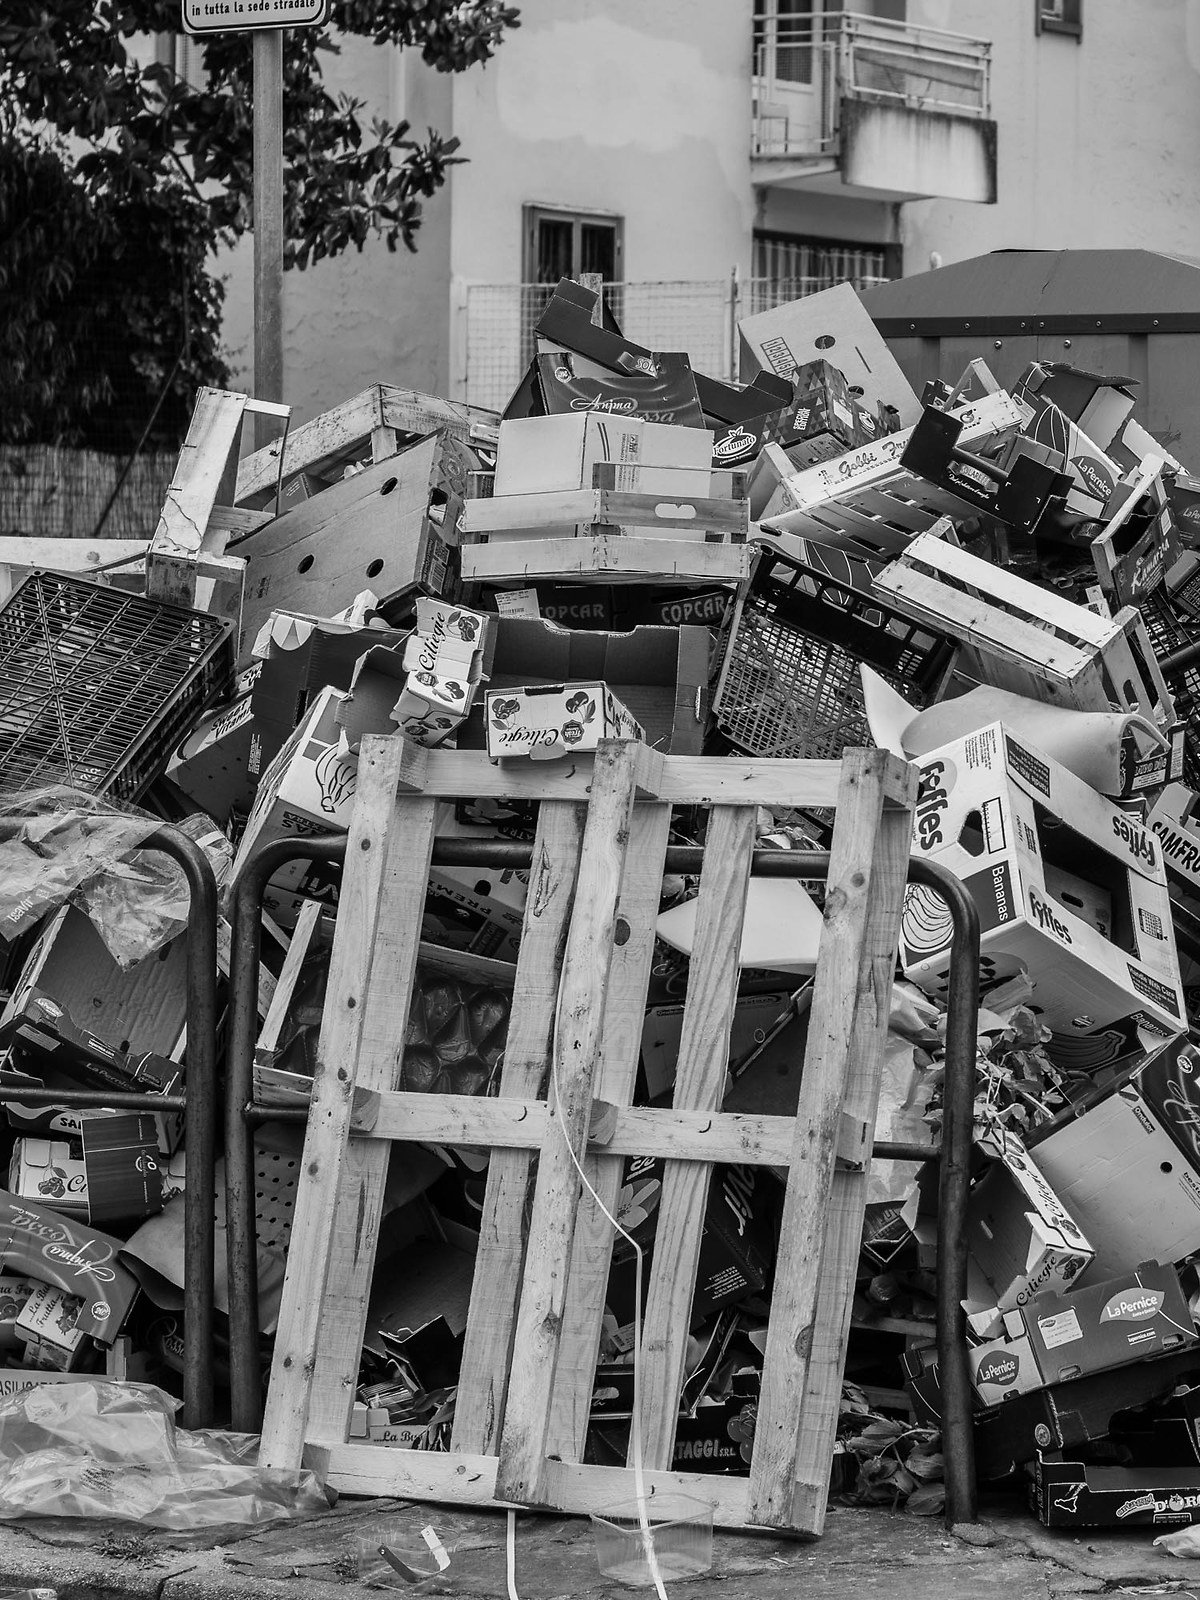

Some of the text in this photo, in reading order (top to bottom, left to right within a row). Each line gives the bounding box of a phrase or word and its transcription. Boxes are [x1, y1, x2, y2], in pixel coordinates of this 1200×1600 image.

[191, 0, 316, 16] in tutta la sede stradale
[635, 358, 657, 373] SOL
[713, 434, 756, 459] Fortunato
[838, 452, 878, 478] Gobbi
[418, 611, 447, 672] Ciliegie
[498, 728, 560, 748] Ciliegie
[991, 865, 1009, 922] Bananas
[1016, 1256, 1057, 1307] Ciliegie
[674, 1439, 719, 1460] TAGGI
